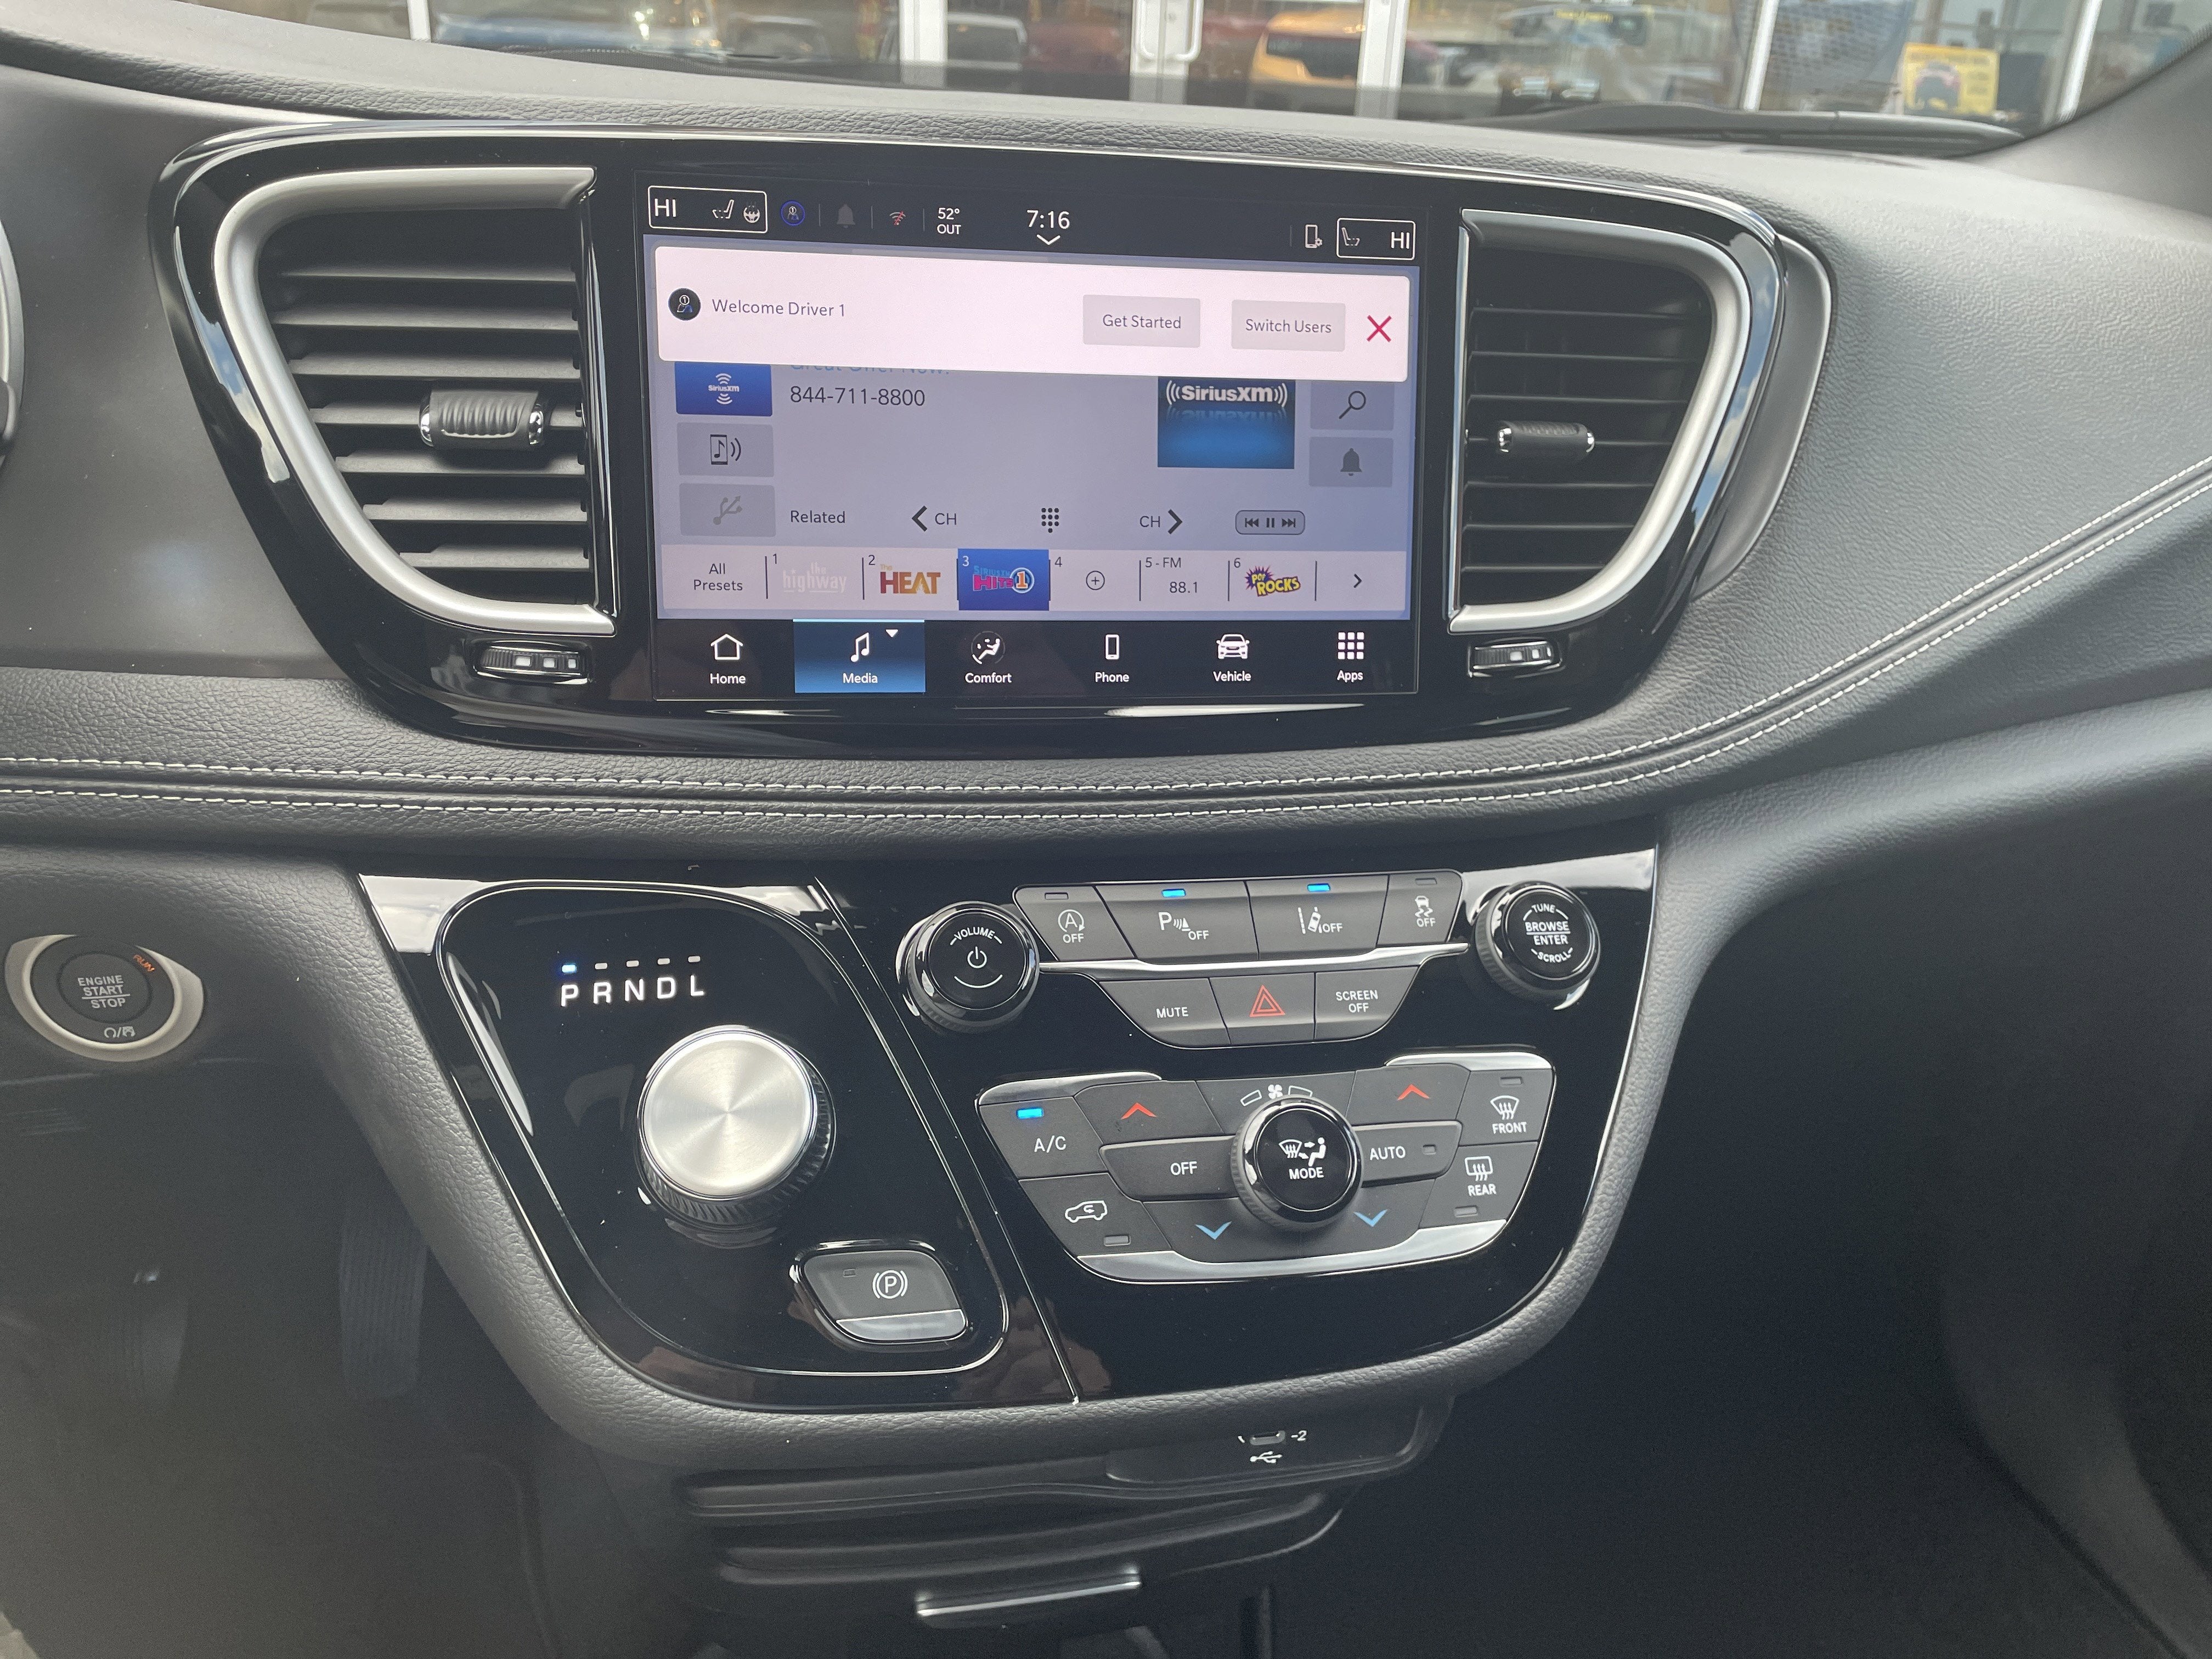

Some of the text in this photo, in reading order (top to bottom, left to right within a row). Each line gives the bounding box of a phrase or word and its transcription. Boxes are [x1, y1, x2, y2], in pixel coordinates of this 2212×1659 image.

[653, 198, 677, 218] HI
[937, 207, 961, 220] 52°
[1026, 210, 1070, 229] 7:16
[936, 223, 962, 235] OUT
[1390, 232, 1410, 250] HI
[712, 298, 845, 317] Welcome Driver 1
[1102, 314, 1182, 329] Get Started
[1245, 318, 1332, 334] Switch Users
[790, 386, 925, 407] 844-711-8800
[790, 510, 846, 524] Related
[934, 513, 957, 526] CH
[1139, 515, 1161, 528] CH
[772, 553, 777, 565] 1
[868, 554, 876, 566] 2
[962, 555, 970, 567] 3
[1054, 557, 1063, 568] 4
[1145, 557, 1153, 568] 5
[1163, 557, 1182, 568] FM
[1234, 557, 1241, 568] 6
[708, 562, 726, 575] All
[693, 578, 743, 592] Presets
[783, 568, 847, 593] highway
[880, 571, 941, 594] HEAT
[1256, 577, 1301, 596] ROCKS
[1169, 581, 1199, 594] 88.1
[709, 672, 746, 685] Home
[842, 672, 878, 685] Media
[964, 672, 1013, 684] Comfort
[1094, 671, 1130, 684] Phone
[1212, 670, 1251, 682] Vehicle
[1336, 670, 1364, 684] Apps
[1531, 902, 1556, 913] TUNE
[1322, 923, 1343, 933] OFF
[1417, 917, 1436, 928] OFF
[1525, 921, 1570, 932] BROWSE
[953, 926, 995, 940] VOLUME
[1062, 933, 1085, 944] OFF
[1188, 930, 1209, 940] OFF
[1533, 934, 1568, 945] ENTER
[1537, 951, 1571, 963] SCROLL
[77, 975, 124, 986] ENGINE
[83, 985, 123, 996] START
[1335, 990, 1379, 1001] SCREEN
[91, 997, 126, 1009] STOP
[1348, 1002, 1369, 1013] OFF
[1156, 1007, 1189, 1018] MUTE
[1491, 1121, 1527, 1135] FRONT
[1034, 1136, 1066, 1153] A/C
[1369, 1146, 1406, 1160] AUTO
[1170, 1161, 1198, 1175] OFF
[1289, 1166, 1324, 1180] MODE
[1467, 1183, 1497, 1197] REAR
